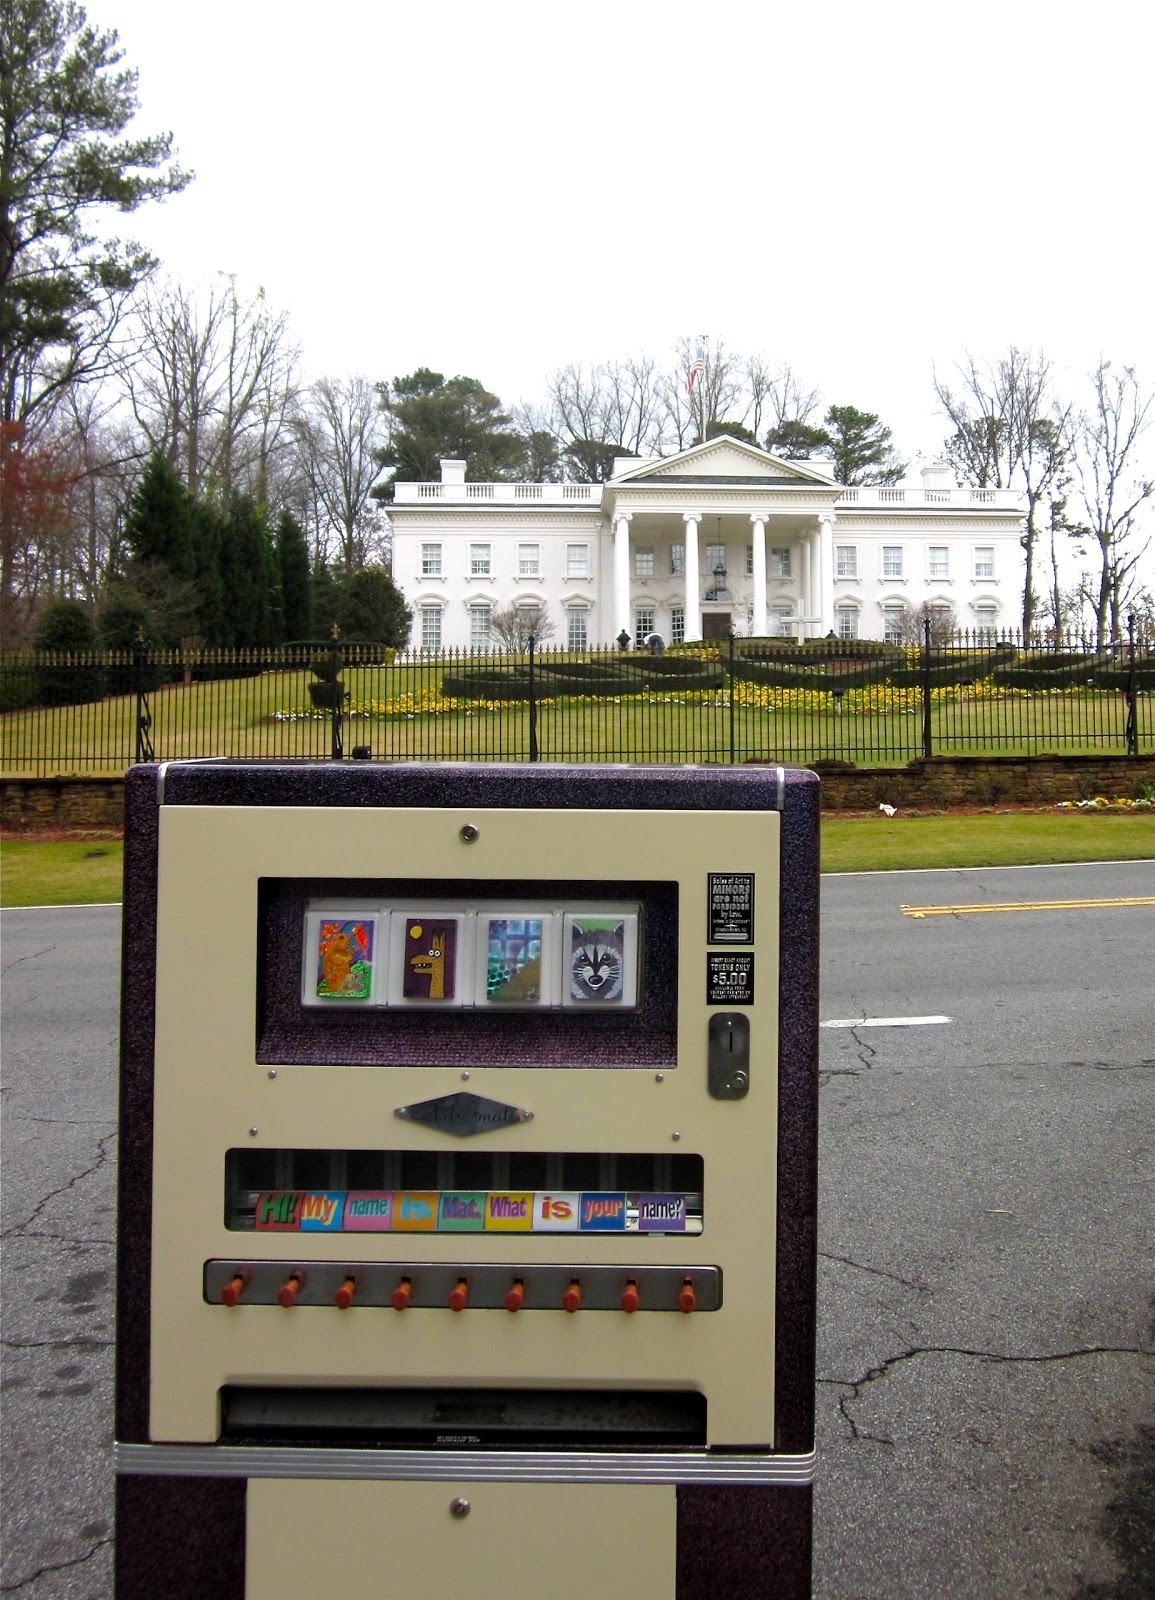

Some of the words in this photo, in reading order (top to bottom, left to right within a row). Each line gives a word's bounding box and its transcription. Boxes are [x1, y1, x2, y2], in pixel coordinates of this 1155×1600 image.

[712, 885, 750, 894] MINORS
[732, 894, 749, 902] not
[712, 972, 747, 985] $5.00
[301, 1194, 339, 1225] My
[349, 1199, 389, 1216] name
[401, 1196, 430, 1219] is
[442, 1196, 482, 1219] Mat.
[490, 1196, 528, 1218] What
[541, 1196, 573, 1220] is
[584, 1200, 623, 1223] your
[642, 1197, 684, 1219] name?
